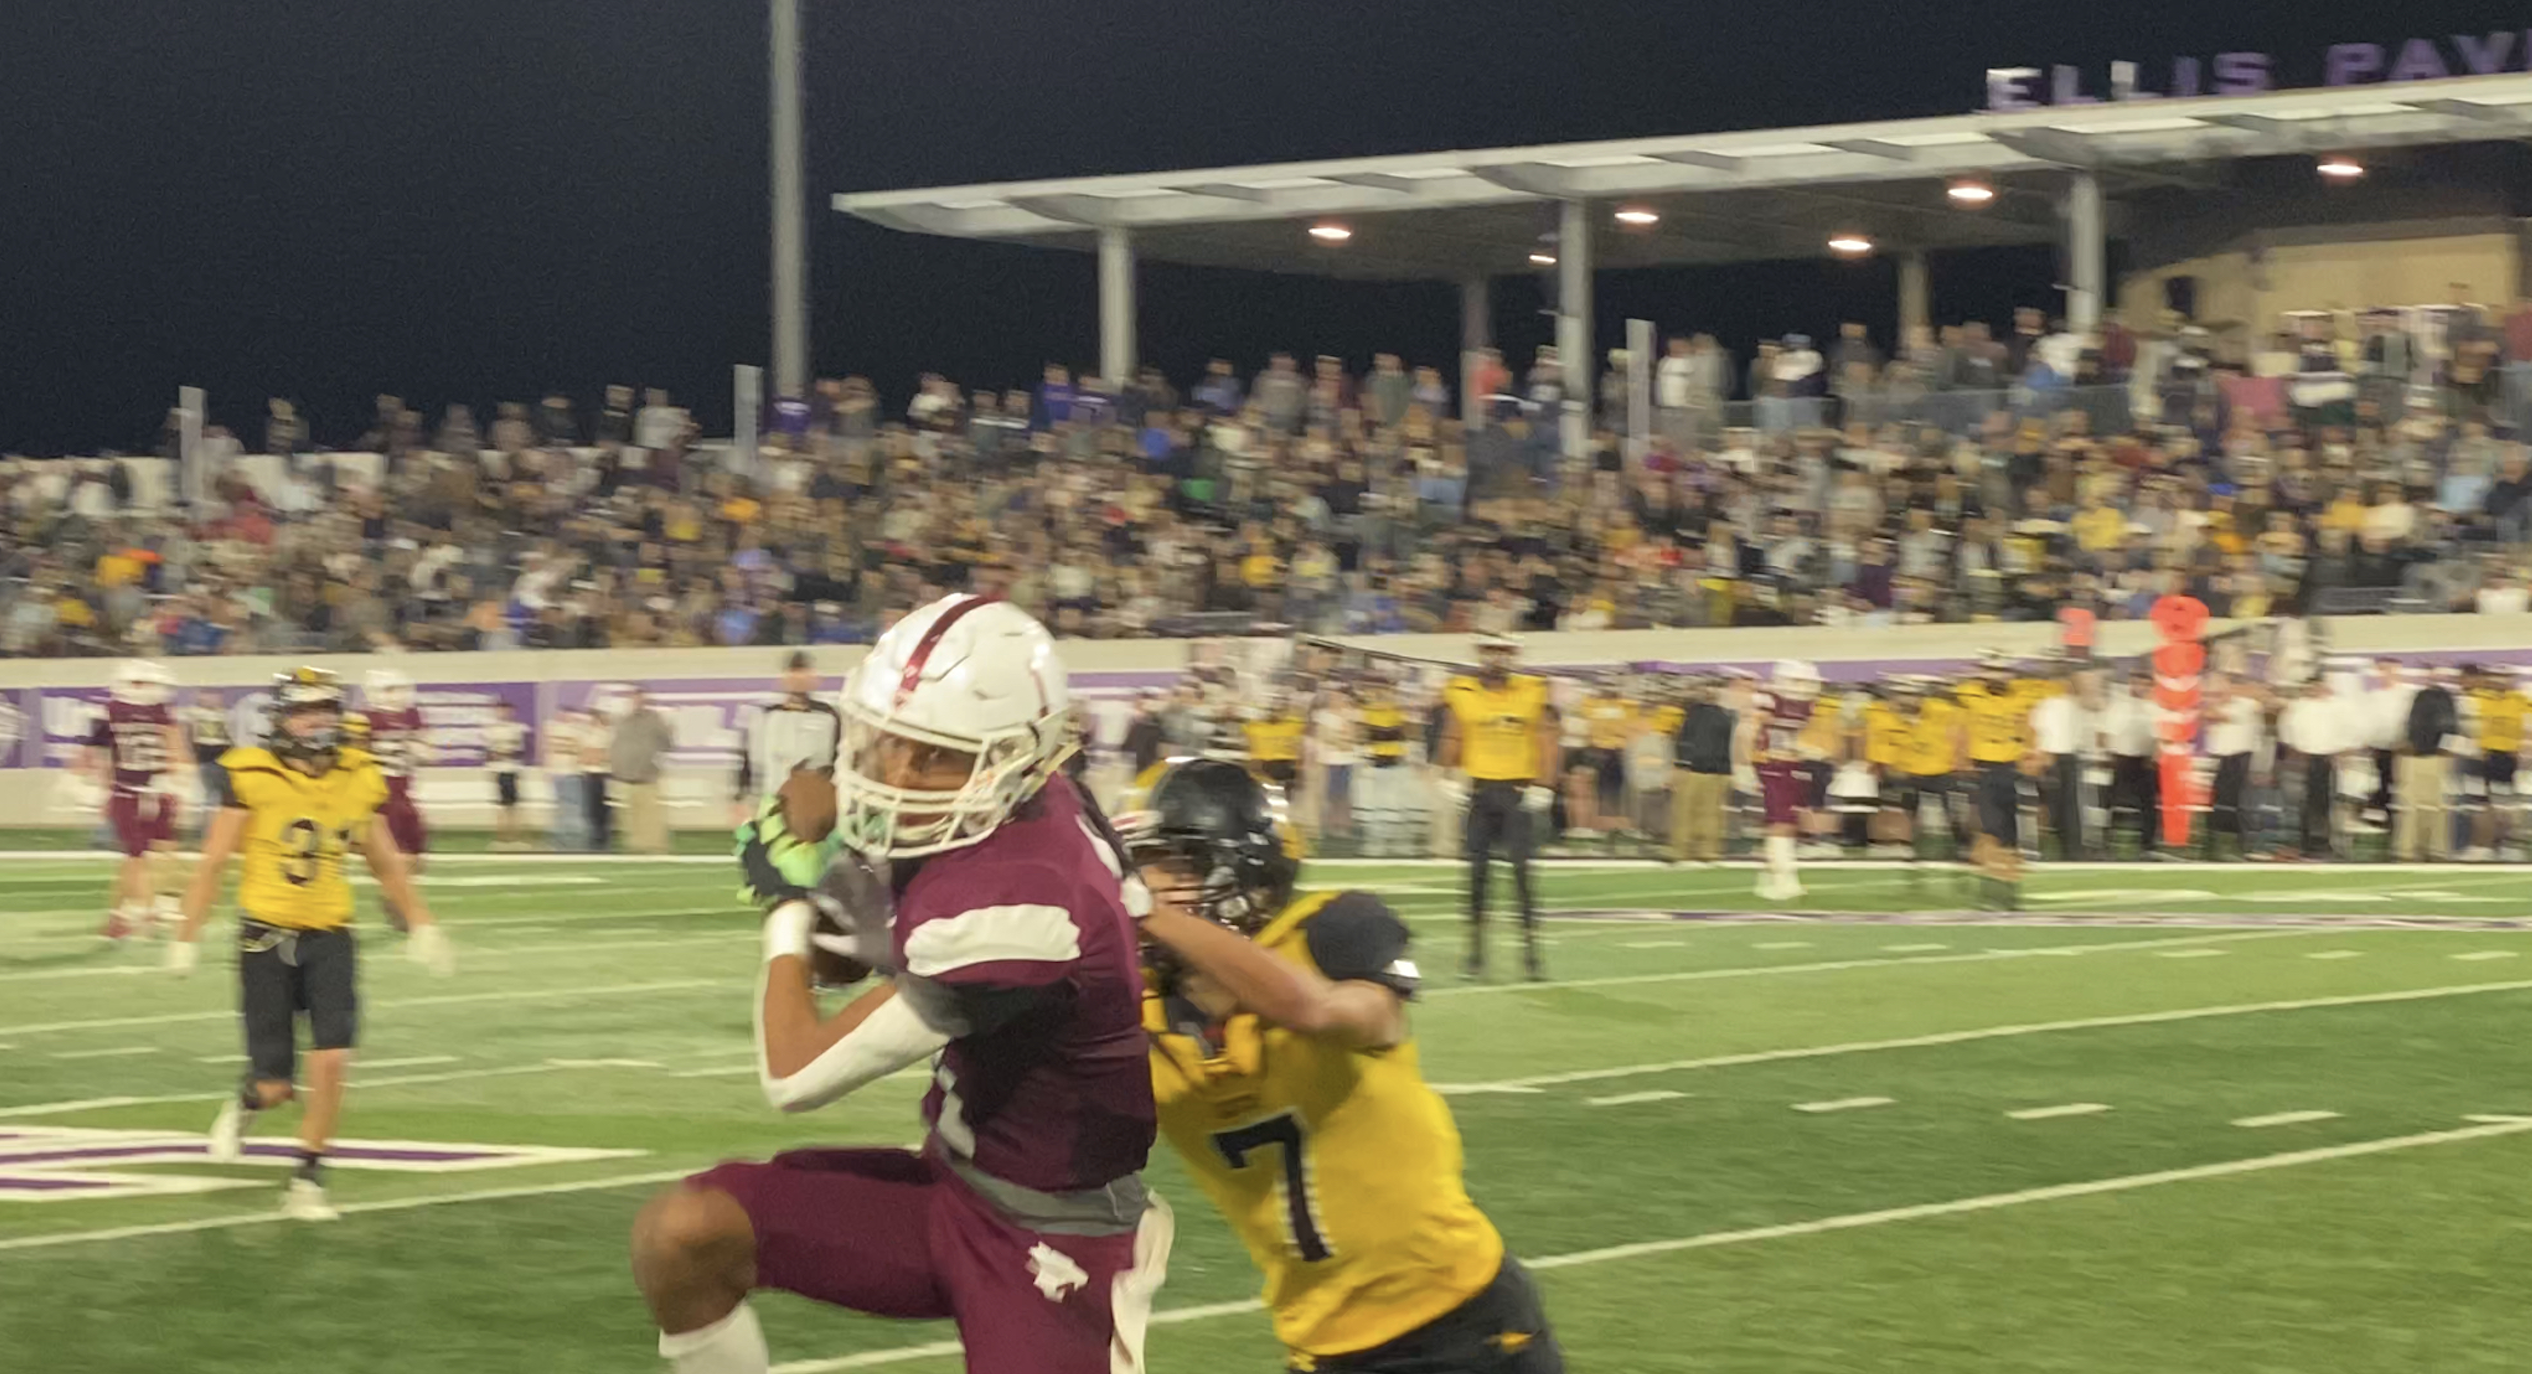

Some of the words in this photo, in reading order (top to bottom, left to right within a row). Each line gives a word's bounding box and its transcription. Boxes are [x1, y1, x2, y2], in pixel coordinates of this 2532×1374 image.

[1985, 52, 2274, 110] ELLIS
[2323, 28, 2532, 87] PAV
[1207, 1106, 1339, 1263] 7
